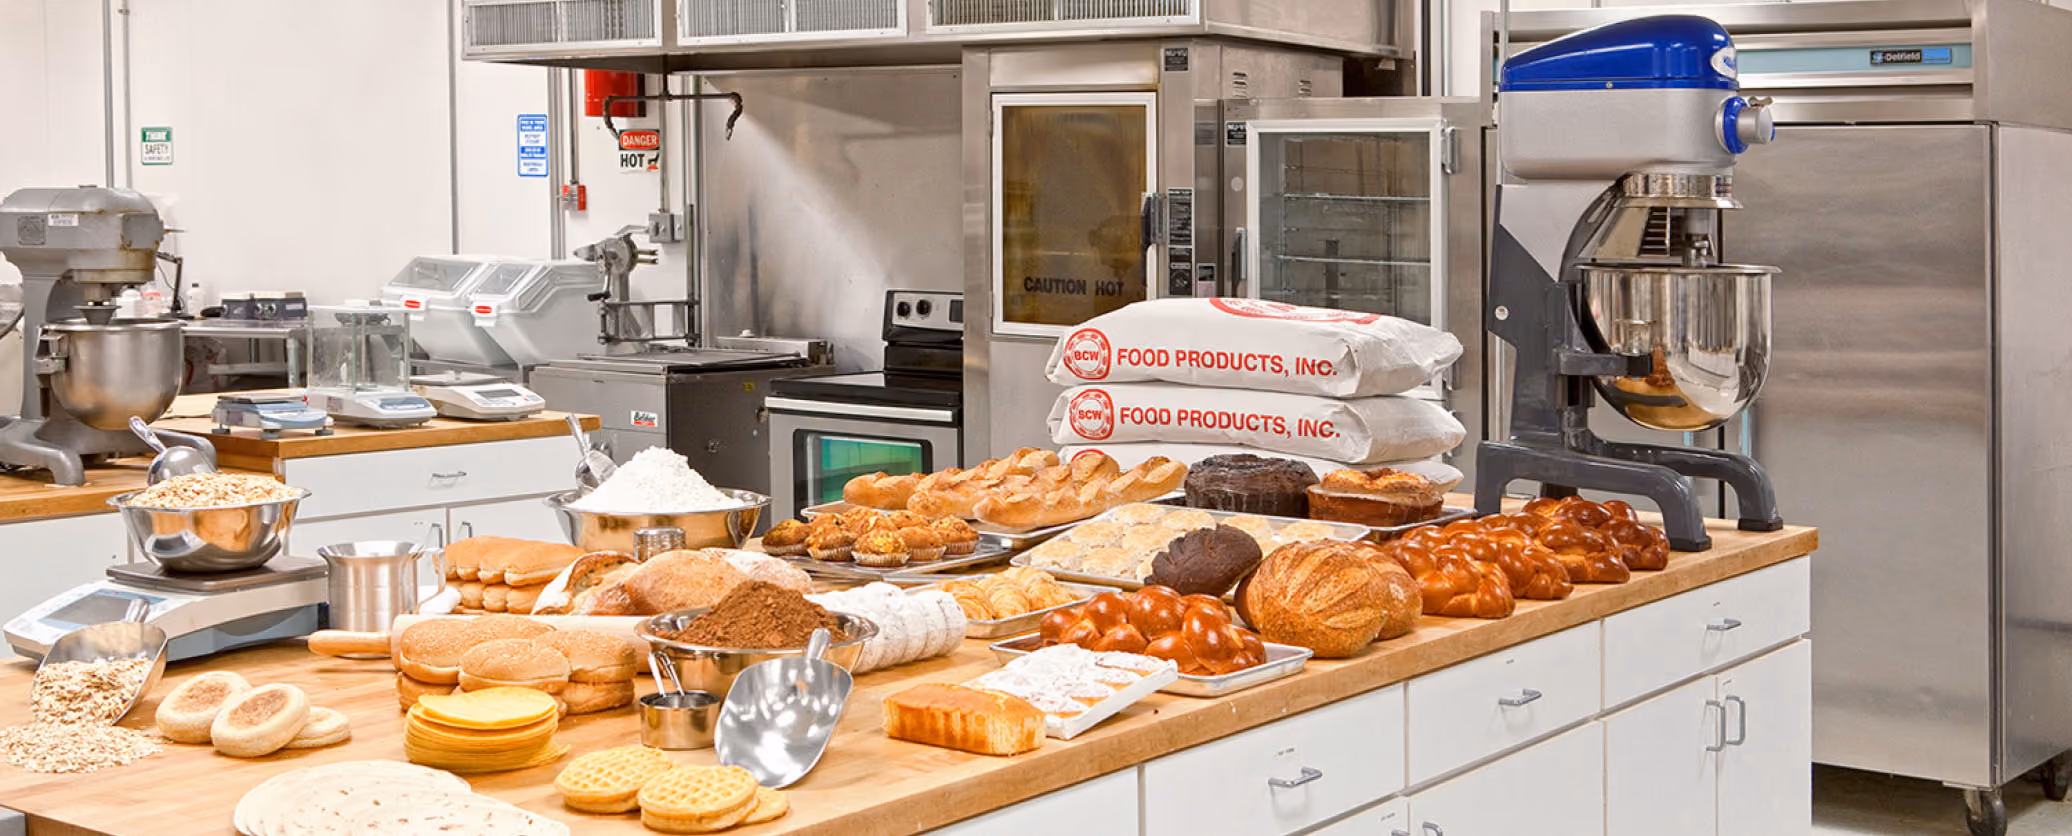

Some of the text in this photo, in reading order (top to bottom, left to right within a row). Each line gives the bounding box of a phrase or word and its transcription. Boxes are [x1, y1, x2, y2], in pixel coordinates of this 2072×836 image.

[1886, 51, 1921, 61] Delfield
[623, 135, 657, 145] DANGER
[145, 143, 168, 154] SAFETY
[621, 153, 645, 167] HOT
[1024, 276, 1124, 296] CAUTION HOT
[1074, 351, 1099, 361] BCW
[1117, 348, 1337, 377] FOOD PRODUCTS, INC.
[1120, 407, 1341, 439] FOOD PRODUCTS, INC.
